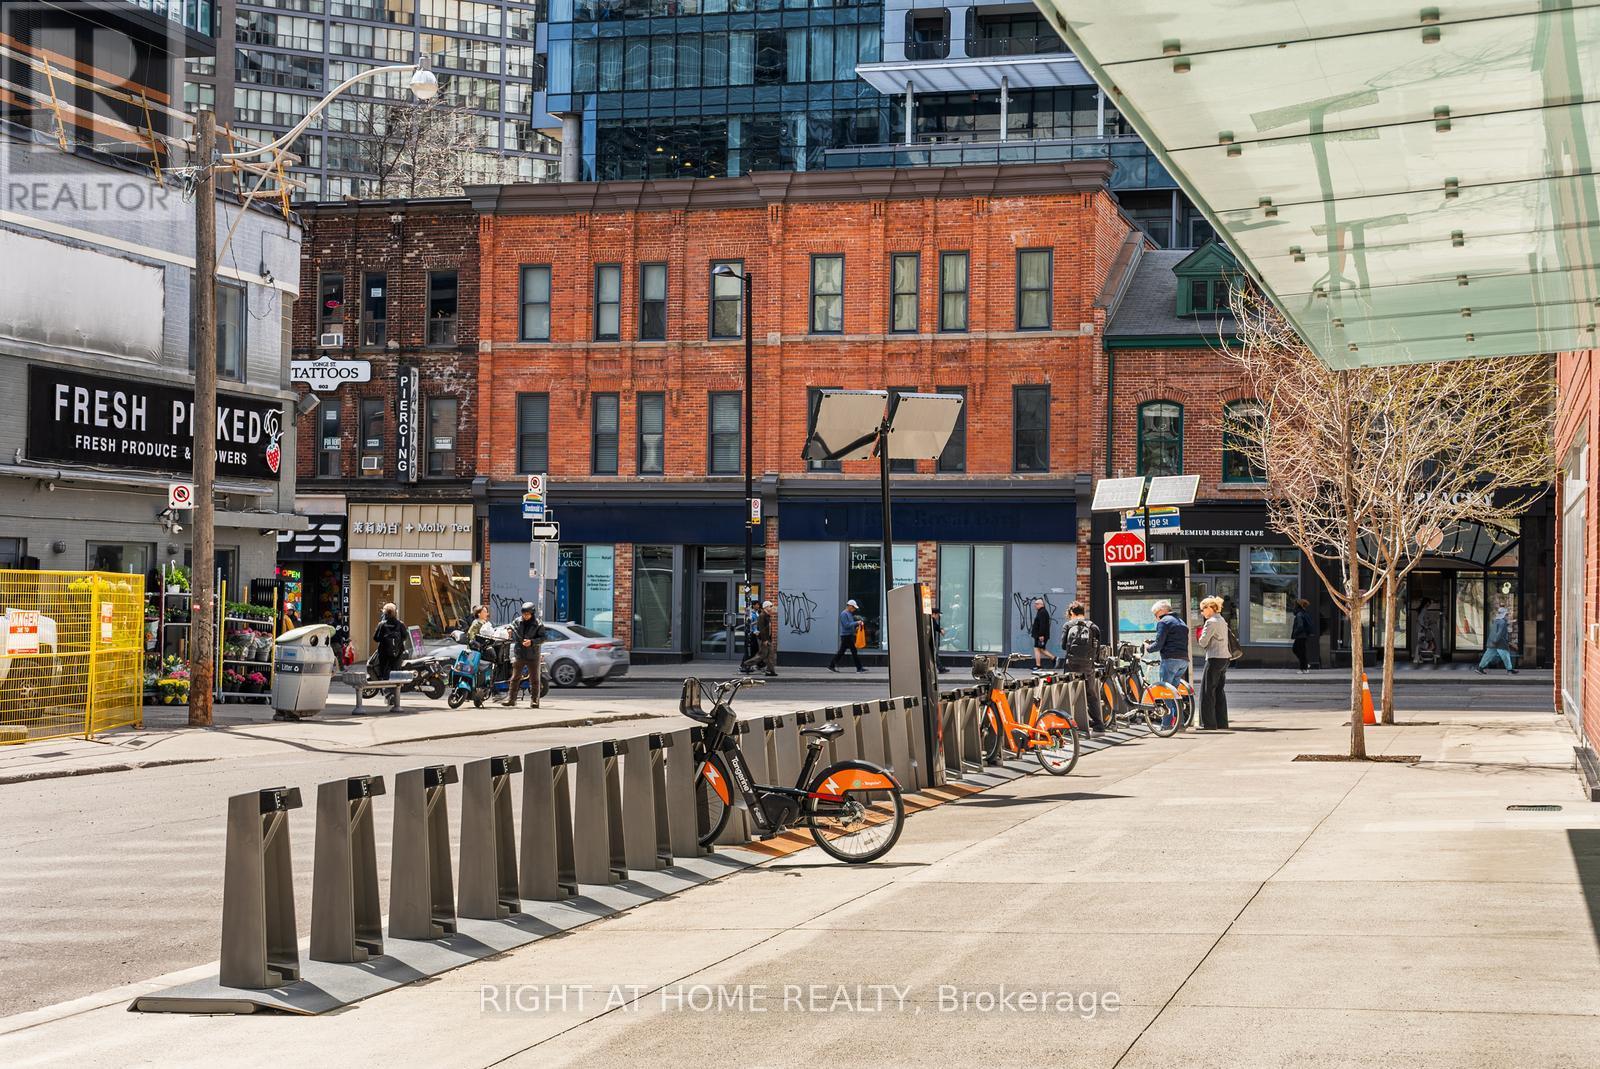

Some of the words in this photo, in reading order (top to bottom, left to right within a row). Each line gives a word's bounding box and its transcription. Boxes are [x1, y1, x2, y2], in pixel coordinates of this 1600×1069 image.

[291, 367, 359, 379] TATTOOS
[55, 383, 148, 432] FRESH
[172, 400, 262, 444] PIKED
[397, 376, 409, 472] PIERCING
[75, 434, 116, 453] FRESH
[121, 439, 178, 459] PRODUCE
[184, 446, 191, 460] &
[418, 522, 446, 534] Molly
[450, 523, 471, 533] Tea
[1162, 518, 1169, 526] St
[377, 550, 403, 558] Oriental
[851, 551, 868, 561] For
[1107, 544, 1144, 561] STOP
[851, 560, 878, 570] Lease
[282, 569, 301, 579] OPEN
[731, 756, 750, 793] Tangerine
